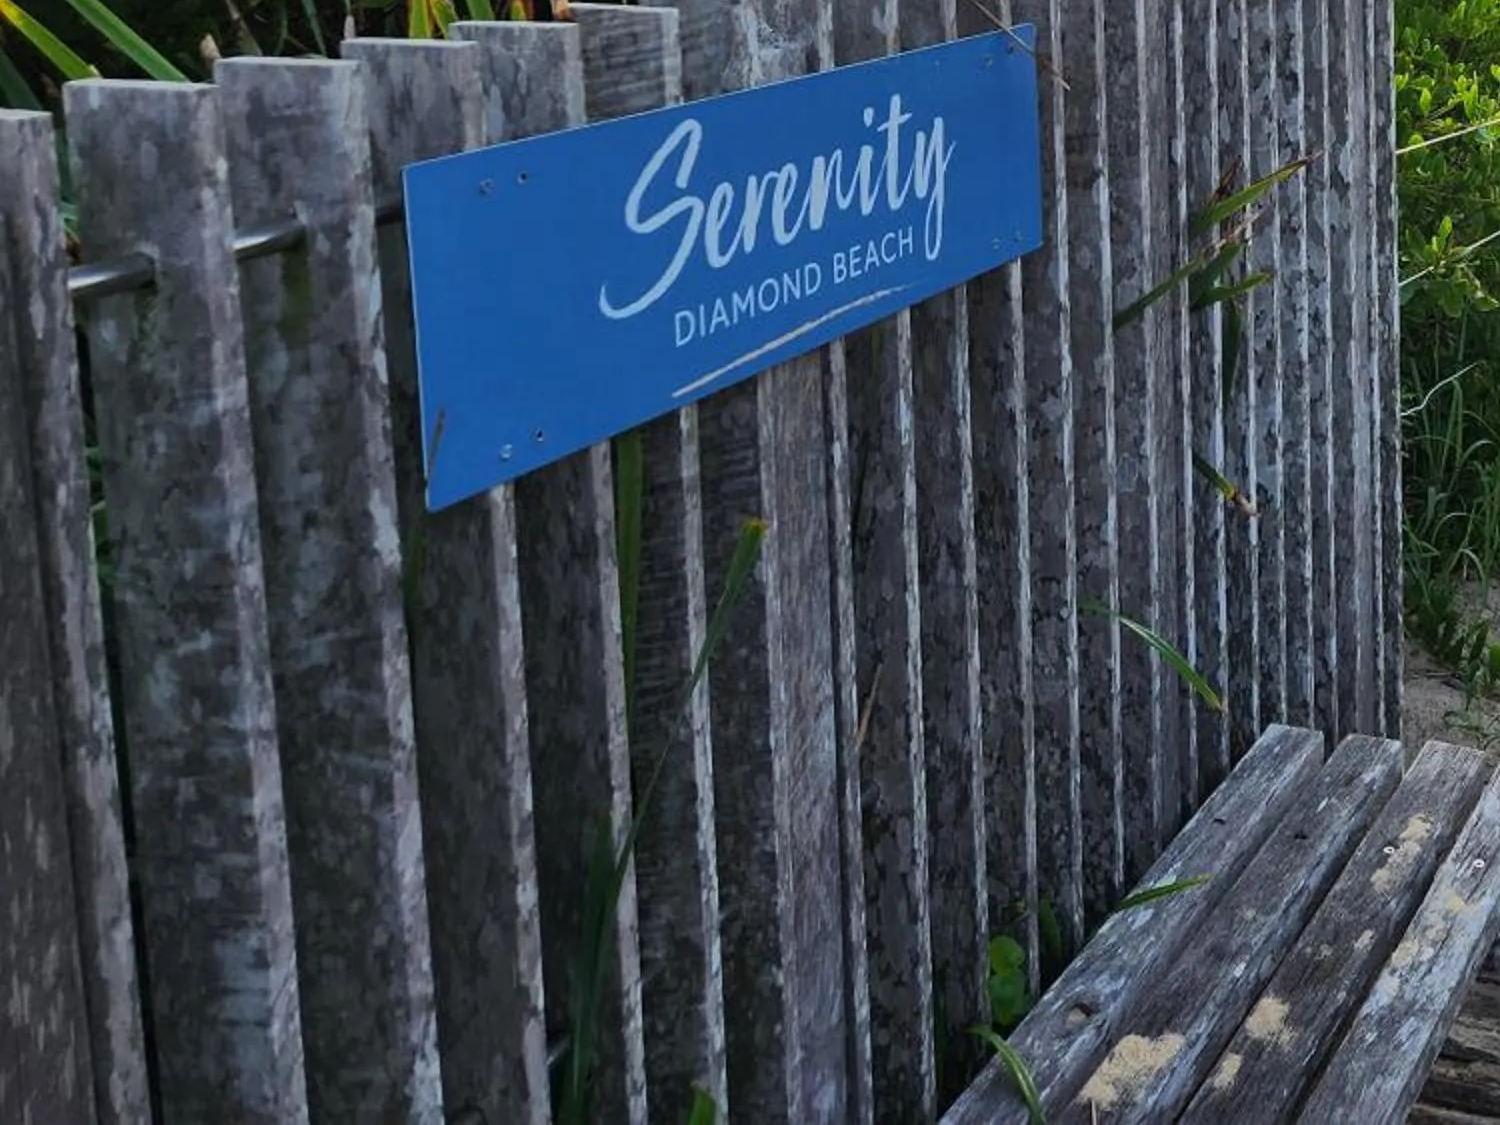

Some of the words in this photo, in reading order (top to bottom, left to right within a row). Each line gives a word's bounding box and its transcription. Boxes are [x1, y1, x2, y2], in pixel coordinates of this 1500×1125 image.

[599, 94, 956, 319] Serenity
[674, 262, 822, 348] DIAMOND
[833, 226, 914, 284] BEACH
